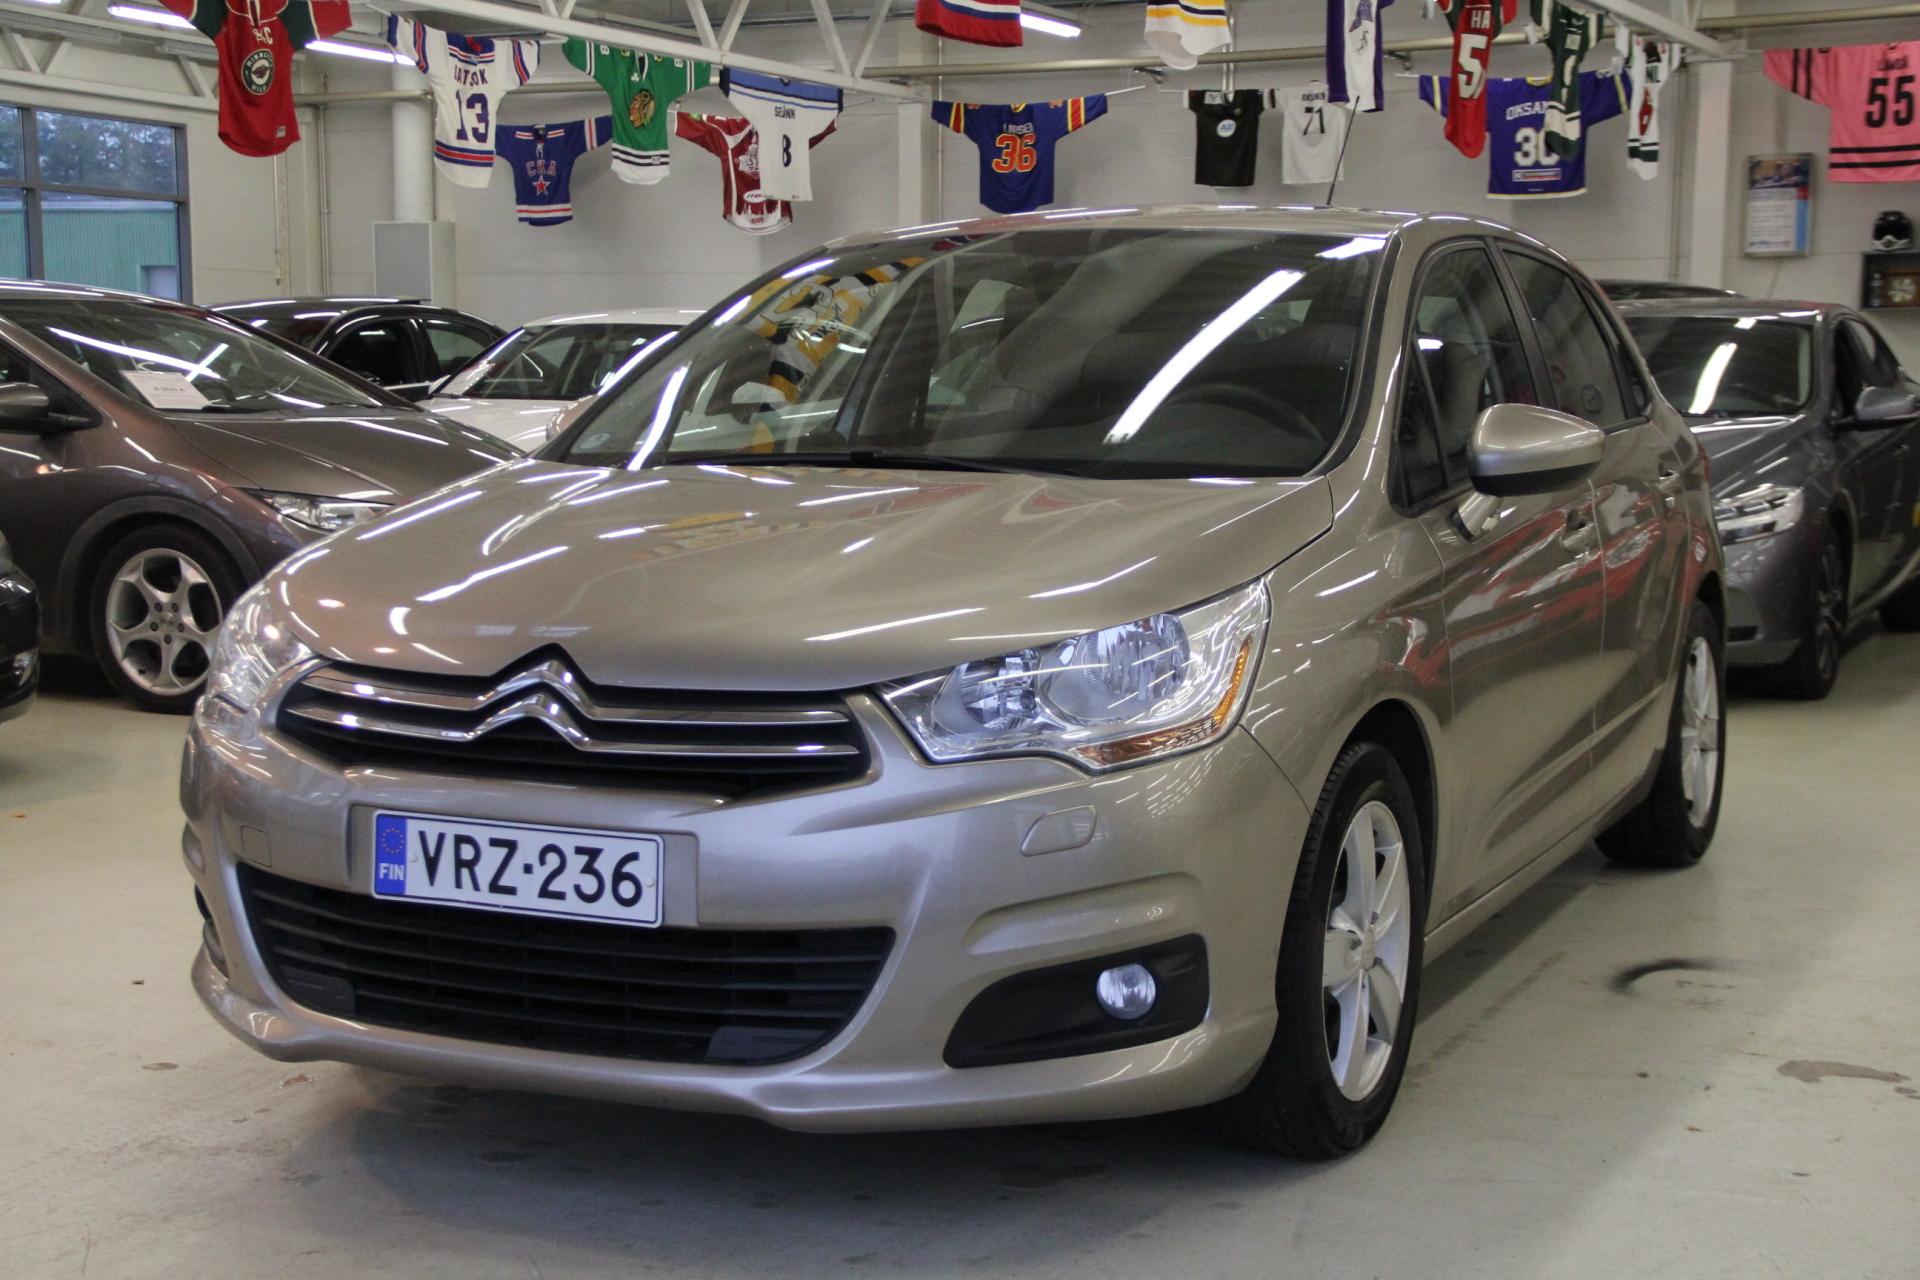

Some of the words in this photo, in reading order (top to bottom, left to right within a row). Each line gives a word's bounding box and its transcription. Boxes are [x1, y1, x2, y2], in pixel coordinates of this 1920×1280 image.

[1457, 33, 1486, 99] 5
[455, 89, 489, 143] 13
[1865, 75, 1915, 128] 55
[991, 133, 1037, 173] 36
[379, 862, 405, 881] FIN
[418, 830, 644, 908] VRZ-236
